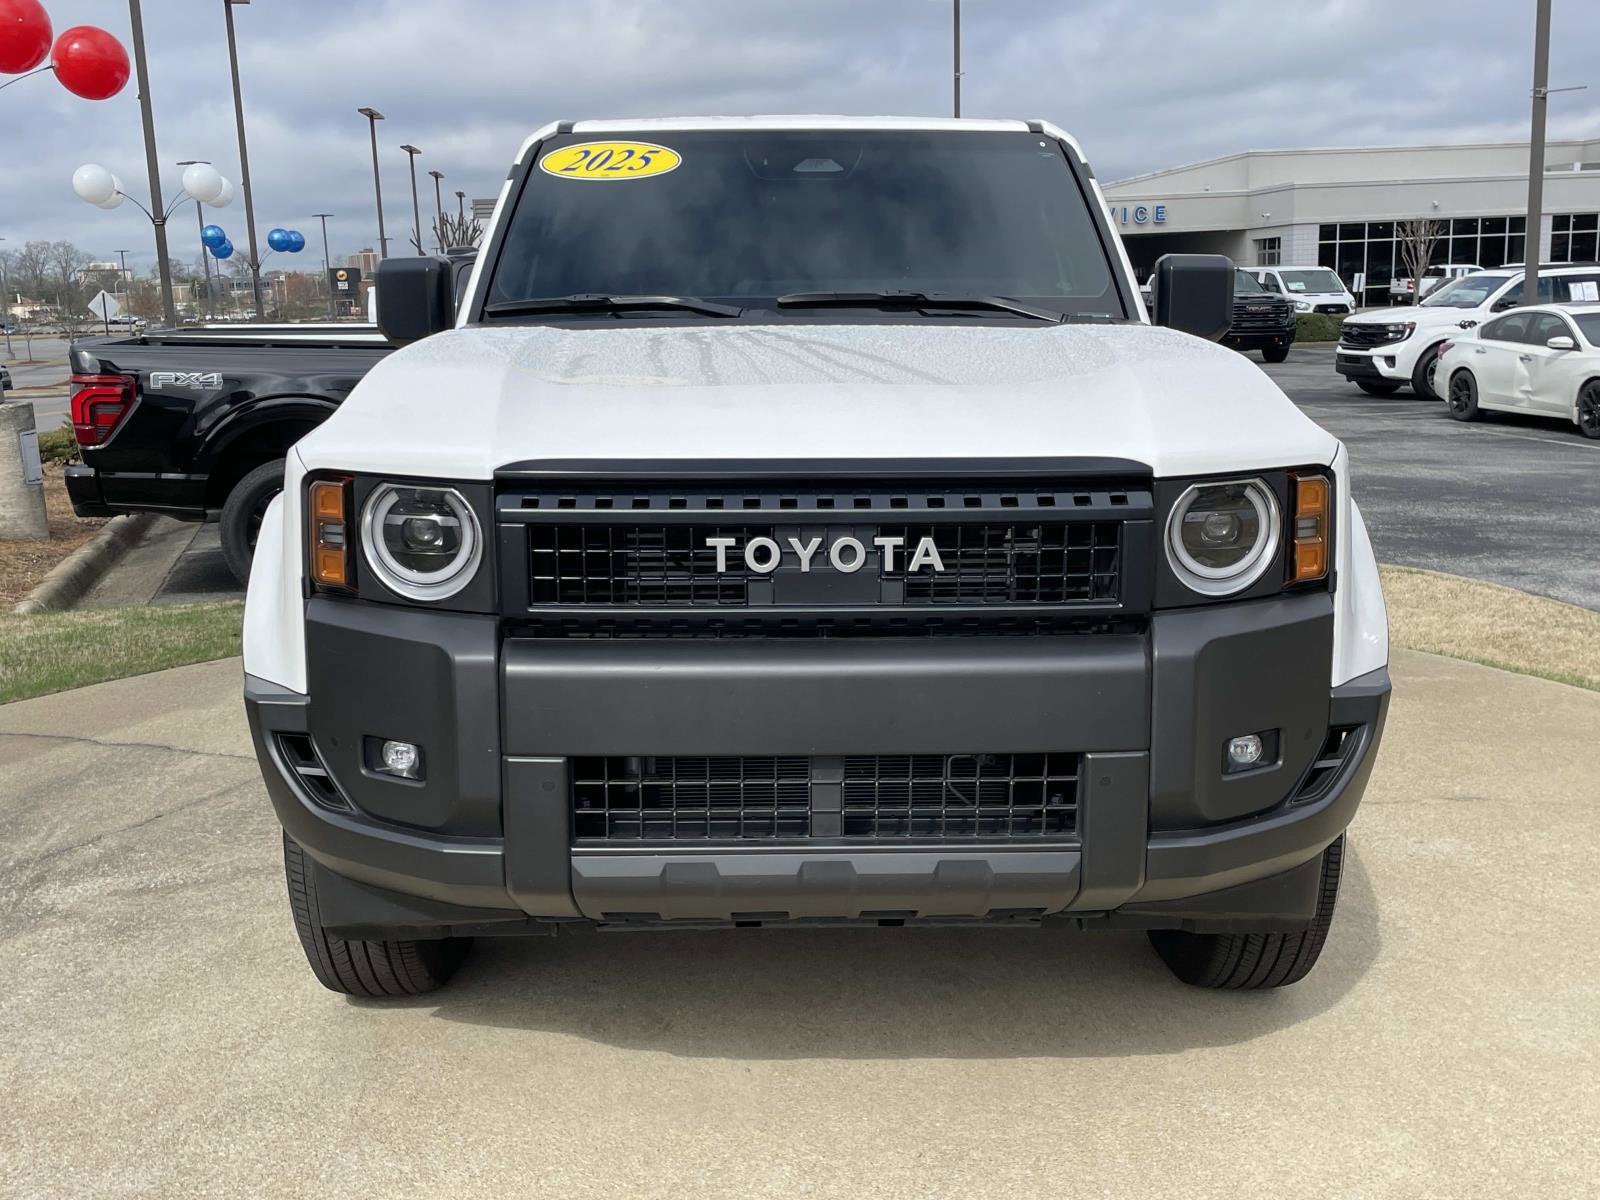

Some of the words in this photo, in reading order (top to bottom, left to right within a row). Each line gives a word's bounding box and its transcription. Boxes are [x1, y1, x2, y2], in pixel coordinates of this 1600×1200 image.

[560, 149, 661, 172] 2025
[150, 371, 223, 390] FX4
[705, 536, 945, 574] TOYOTA
